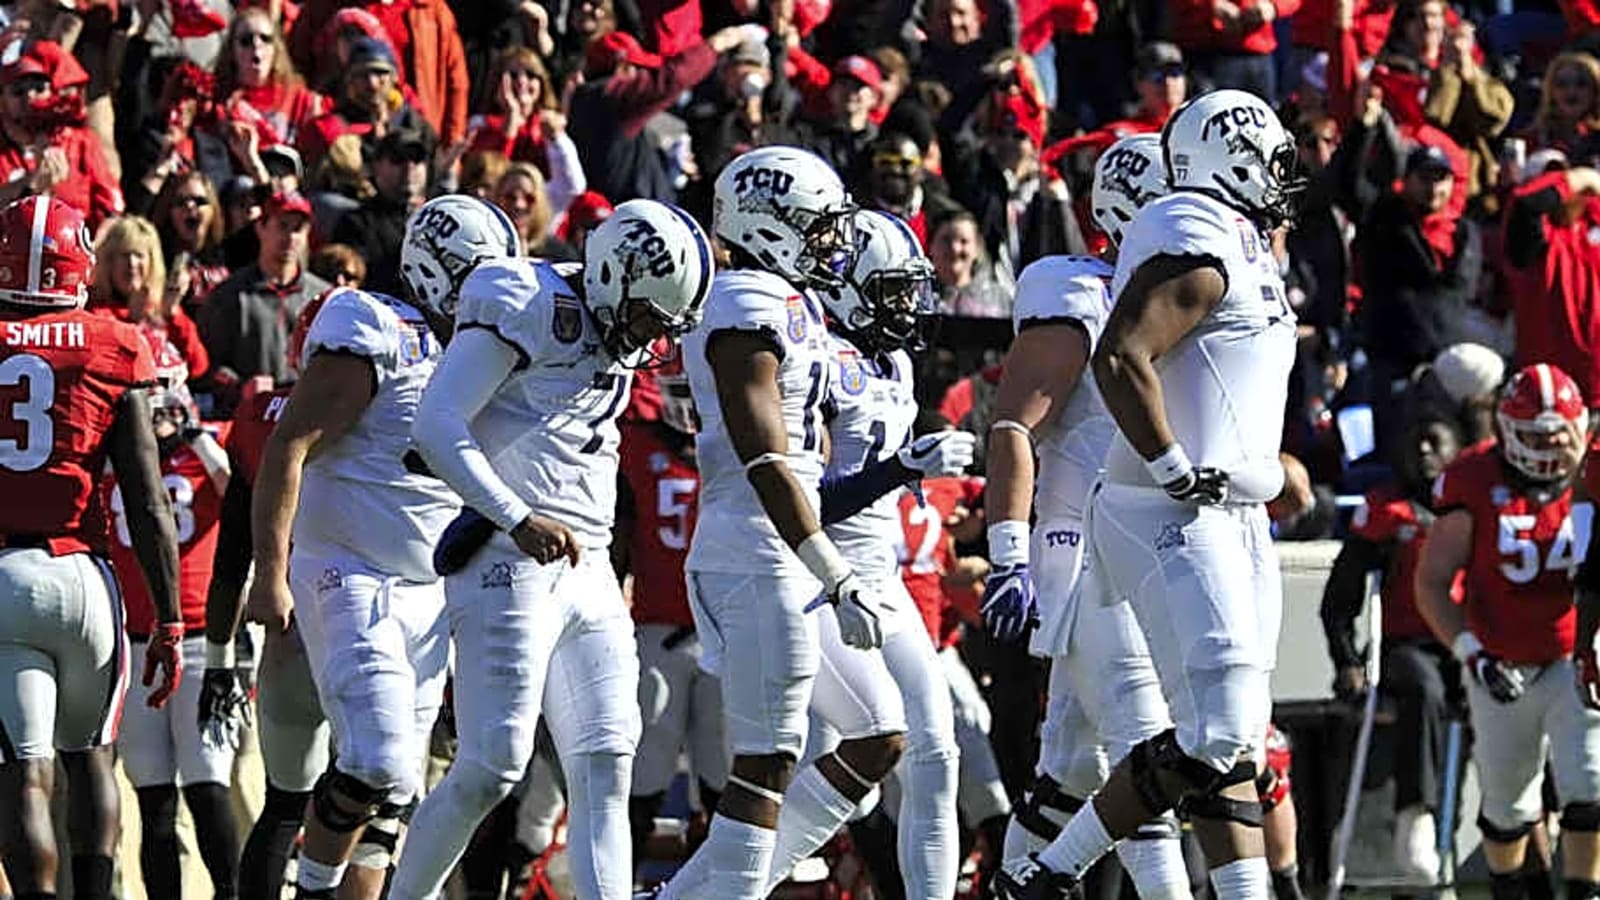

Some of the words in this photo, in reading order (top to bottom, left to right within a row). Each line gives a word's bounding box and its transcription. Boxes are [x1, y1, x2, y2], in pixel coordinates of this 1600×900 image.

[1205, 106, 1267, 138] TCU
[1102, 148, 1151, 177] TCU
[733, 166, 795, 196] TCU
[414, 207, 460, 239] TCU
[622, 219, 676, 278] TCU
[42, 267, 57, 289] 3
[6, 321, 85, 347] SMITH
[0, 353, 55, 472] 3
[658, 479, 697, 551] 5
[1046, 530, 1081, 549] TCU
[1498, 502, 1595, 584] 54
